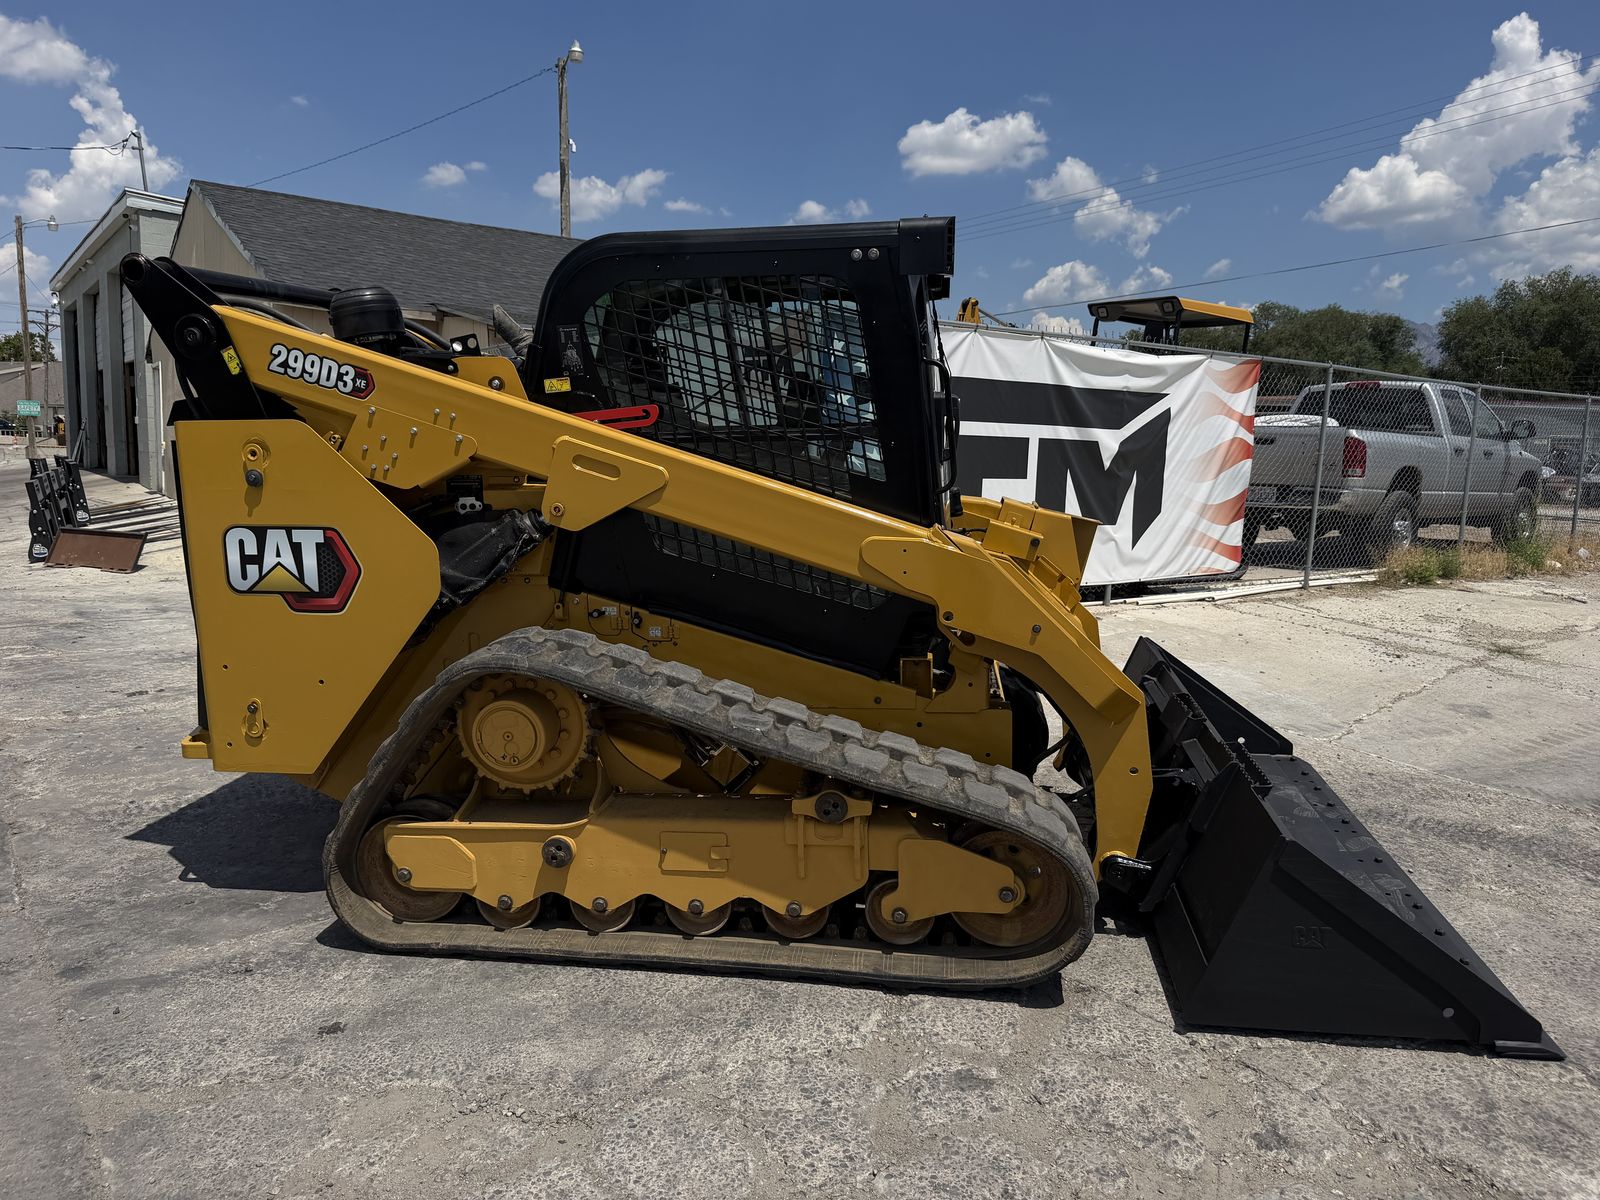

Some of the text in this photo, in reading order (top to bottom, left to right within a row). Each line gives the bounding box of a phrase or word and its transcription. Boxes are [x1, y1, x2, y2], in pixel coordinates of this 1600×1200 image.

[268, 344, 367, 393] 299D3 XE
[225, 526, 325, 593] CAT
